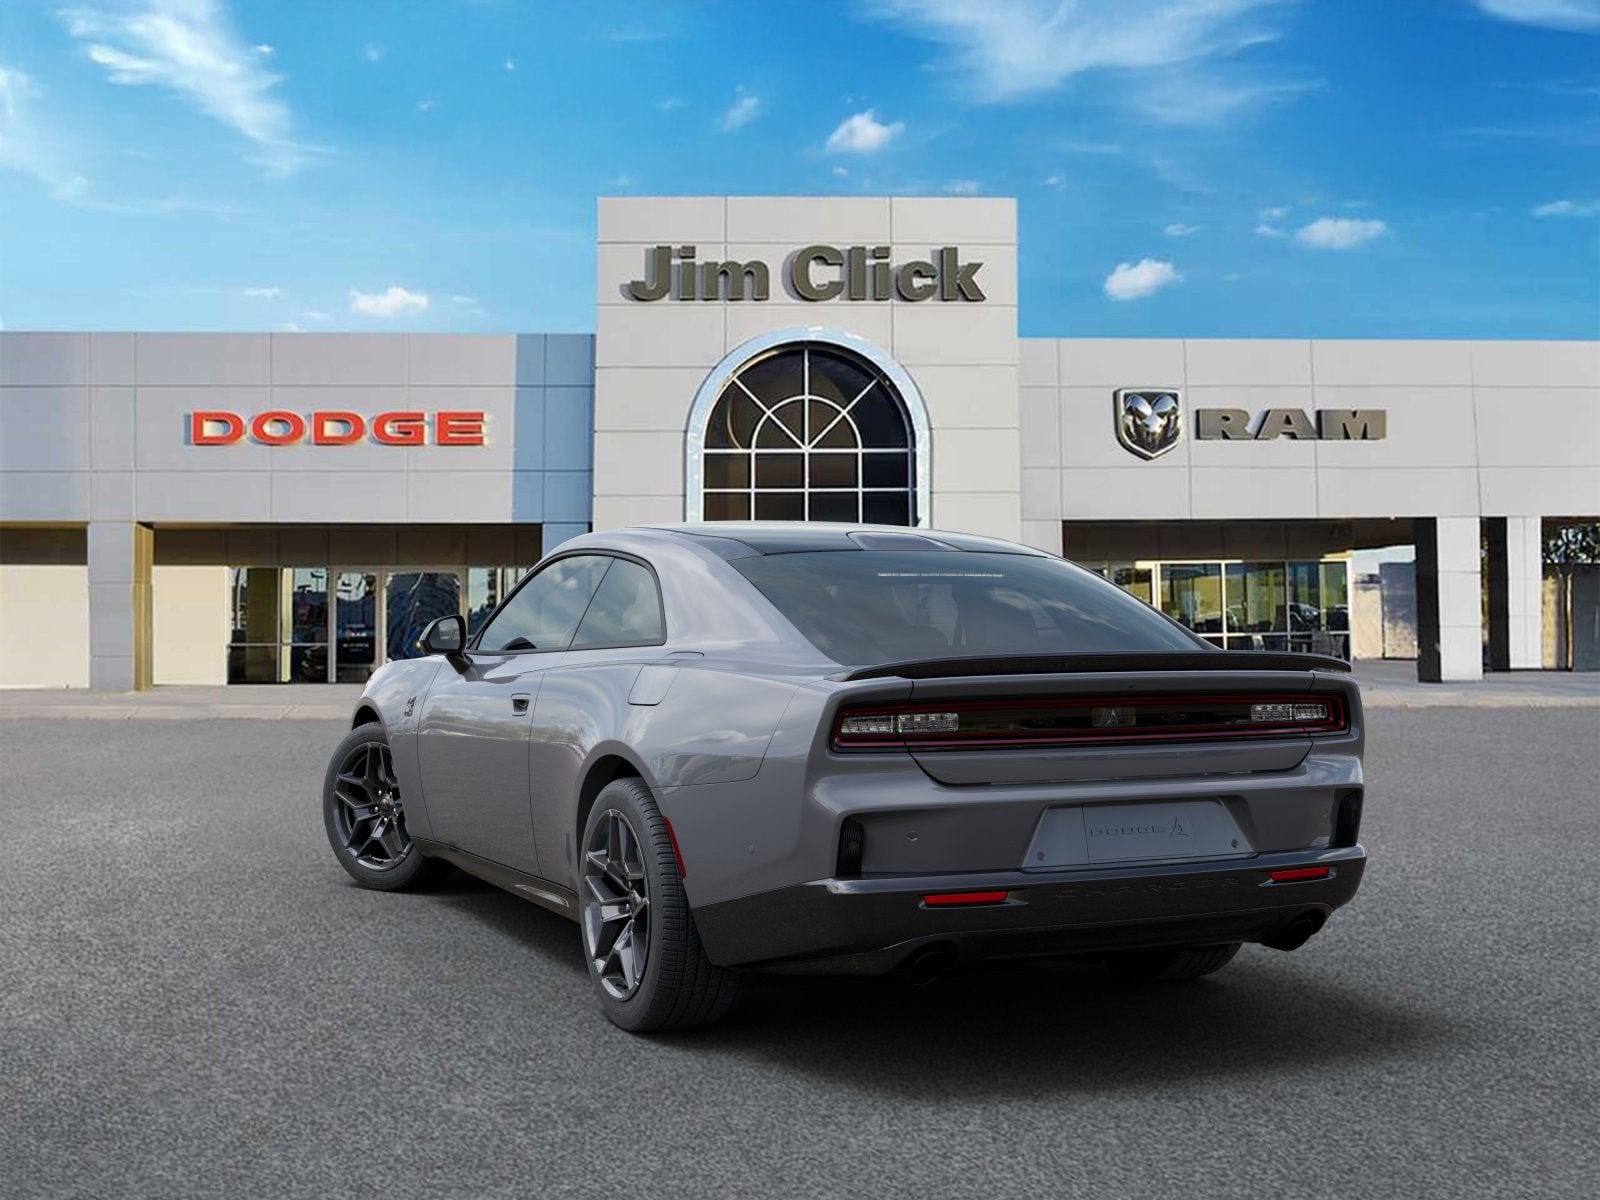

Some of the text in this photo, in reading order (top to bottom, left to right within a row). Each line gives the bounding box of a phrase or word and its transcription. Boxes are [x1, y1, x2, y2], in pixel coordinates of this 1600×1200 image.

[628, 244, 986, 302] Jim Click
[189, 410, 486, 446] DODGE
[1194, 408, 1388, 441] RAM
[1089, 824, 1168, 838] DODGE
